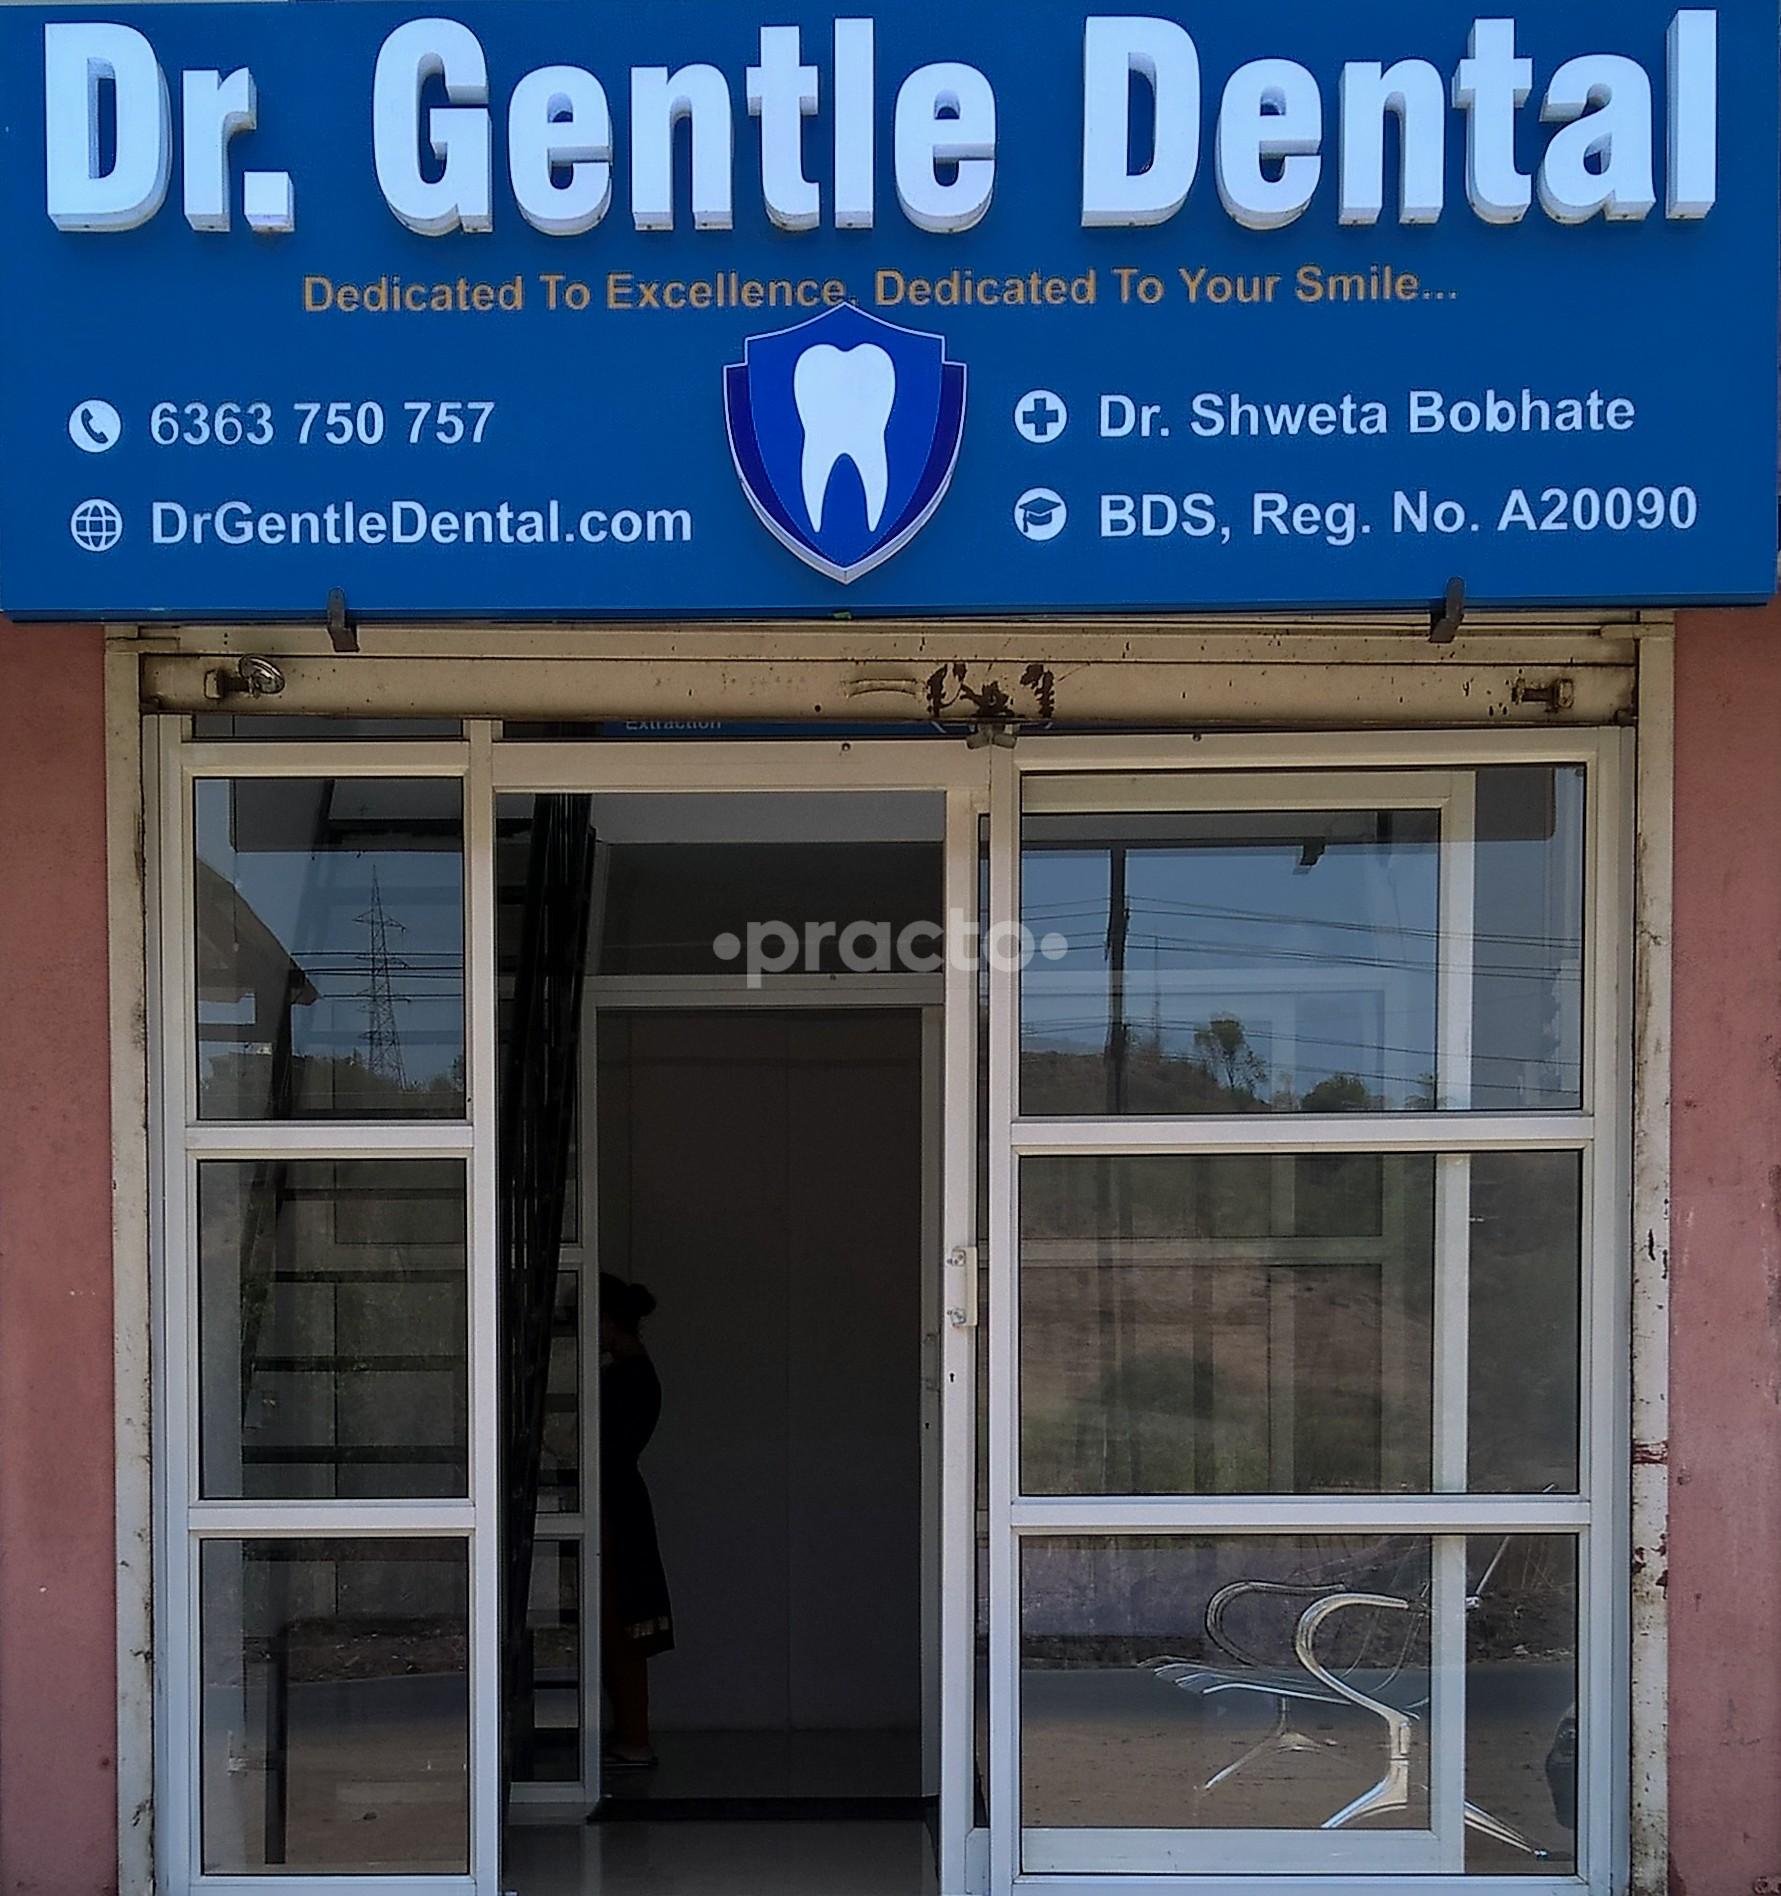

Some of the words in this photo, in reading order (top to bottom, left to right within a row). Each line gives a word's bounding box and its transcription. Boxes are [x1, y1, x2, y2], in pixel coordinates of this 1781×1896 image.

[44, 22, 295, 233] Dr.
[373, 18, 995, 236] Gentle
[1081, 9, 1717, 230] Dental
[303, 276, 523, 312] Dedicated
[540, 274, 591, 311] To
[874, 268, 1096, 307] Dedicated
[1112, 267, 1164, 304] To
[1178, 266, 1281, 304] Your
[1294, 264, 1459, 303] Smile...
[150, 401, 275, 446] 6363
[294, 401, 385, 445] 750
[405, 401, 497, 444] 757
[1099, 395, 1170, 437] Dr.
[1190, 393, 1388, 435] Shweta
[1408, 389, 1636, 433] Bobhate
[151, 499, 693, 546] DrGentleDental.com
[1099, 493, 1232, 545] BDS,
[1251, 492, 1372, 546] Reg.
[1393, 489, 1480, 533] No.
[1497, 486, 1698, 532] A20090
